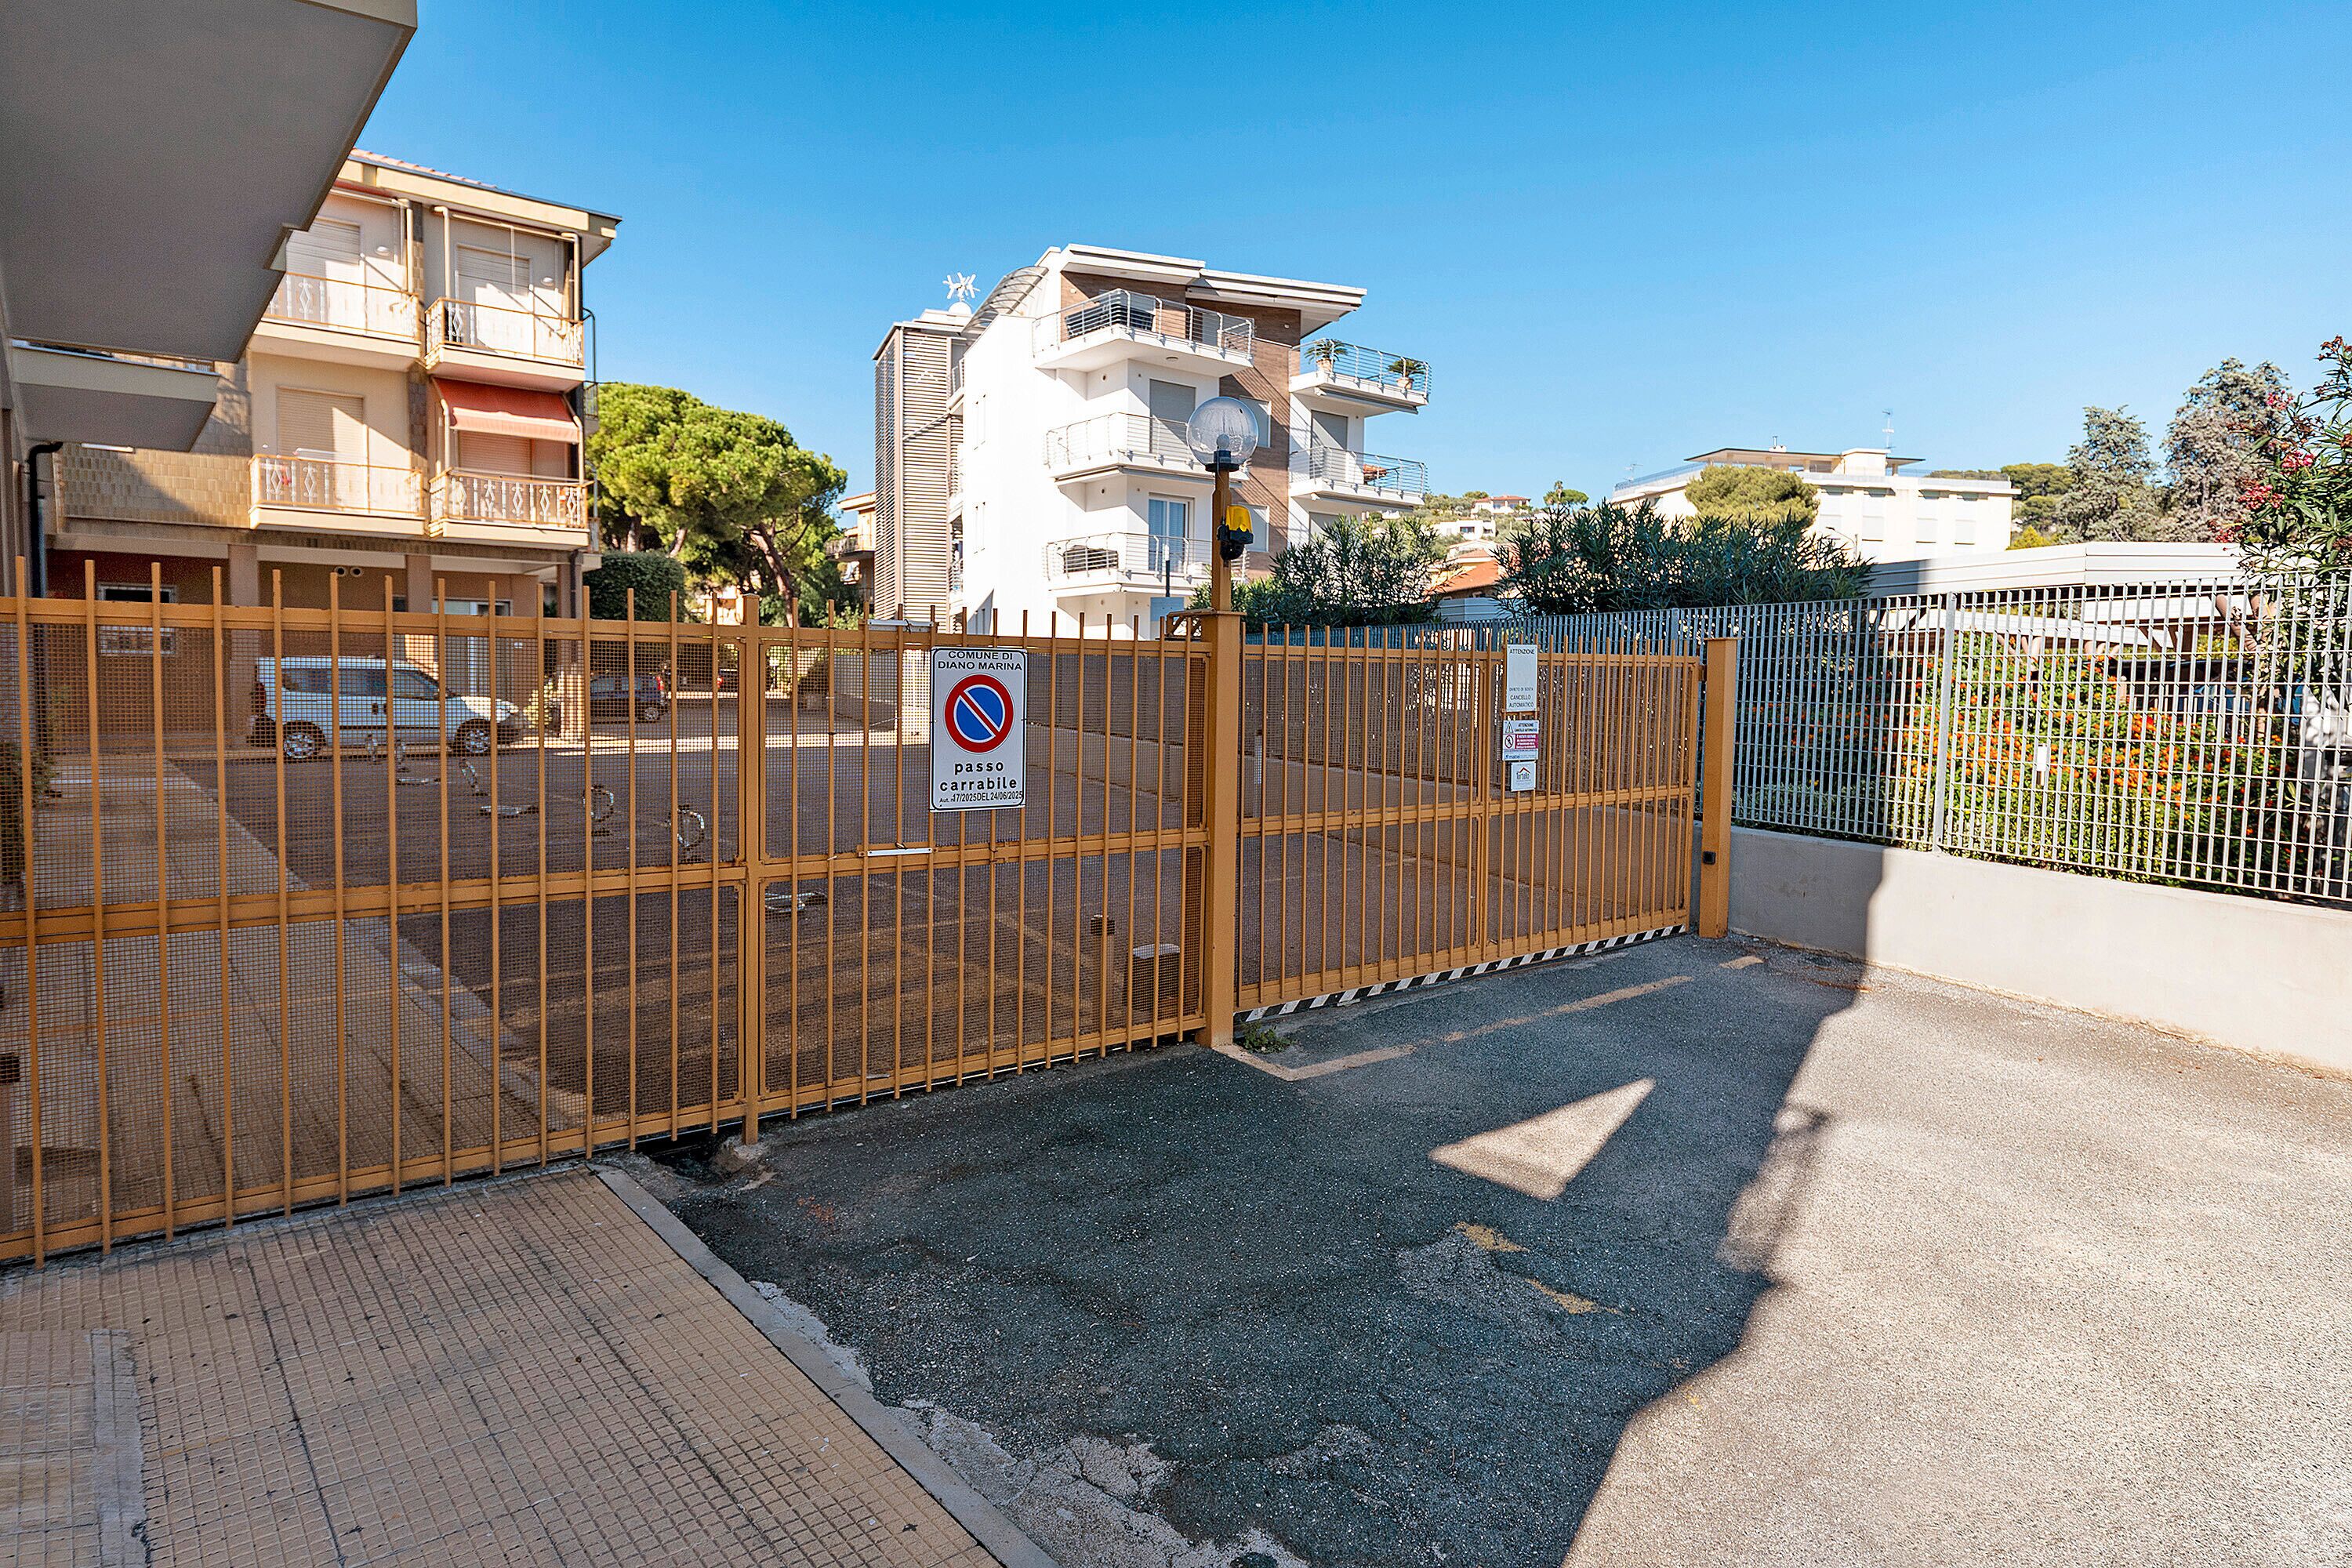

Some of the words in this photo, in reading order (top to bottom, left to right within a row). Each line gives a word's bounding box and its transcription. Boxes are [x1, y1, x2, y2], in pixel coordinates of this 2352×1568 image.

[948, 651, 999, 660] COMUNE
[938, 661, 975, 670] DIANO
[978, 662, 1022, 671] MARINA
[954, 762, 1004, 775] passo
[939, 777, 1016, 791] carrabile
[990, 790, 1022, 800] 24/06/2025
